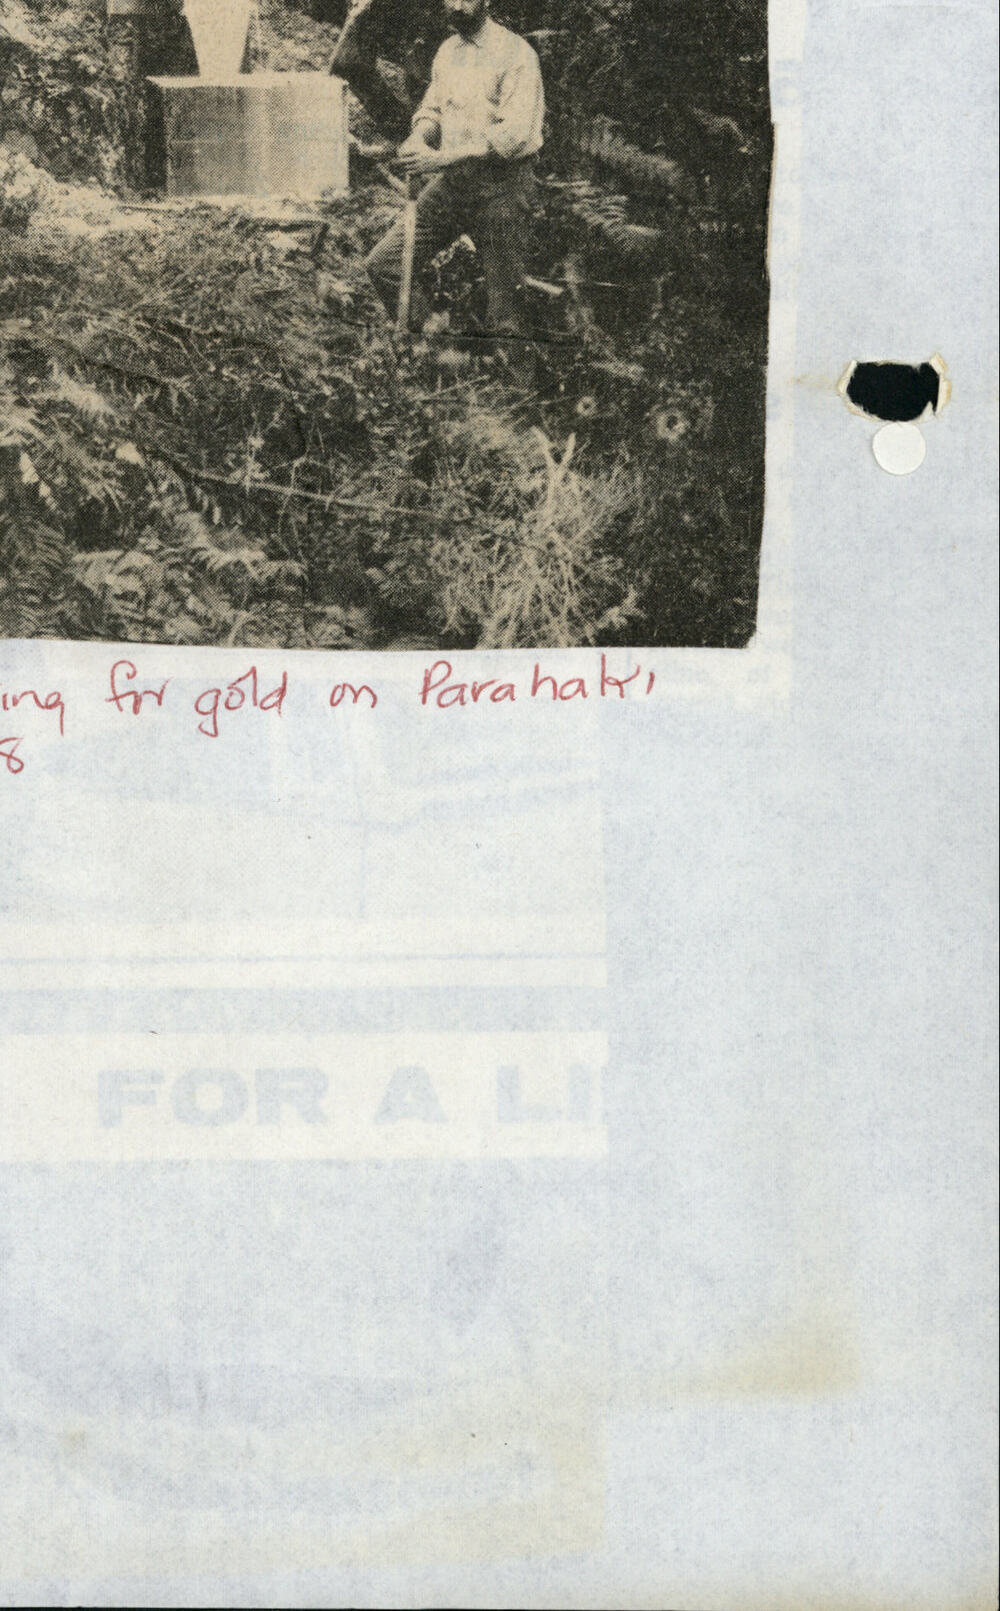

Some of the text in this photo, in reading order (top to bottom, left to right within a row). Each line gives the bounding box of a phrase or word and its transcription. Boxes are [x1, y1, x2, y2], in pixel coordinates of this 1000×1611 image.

[105, 659, 173, 717] for
[193, 664, 289, 739] gold
[328, 680, 379, 710] on
[97, 1066, 330, 1129] FOR
[372, 1066, 449, 1125] A
